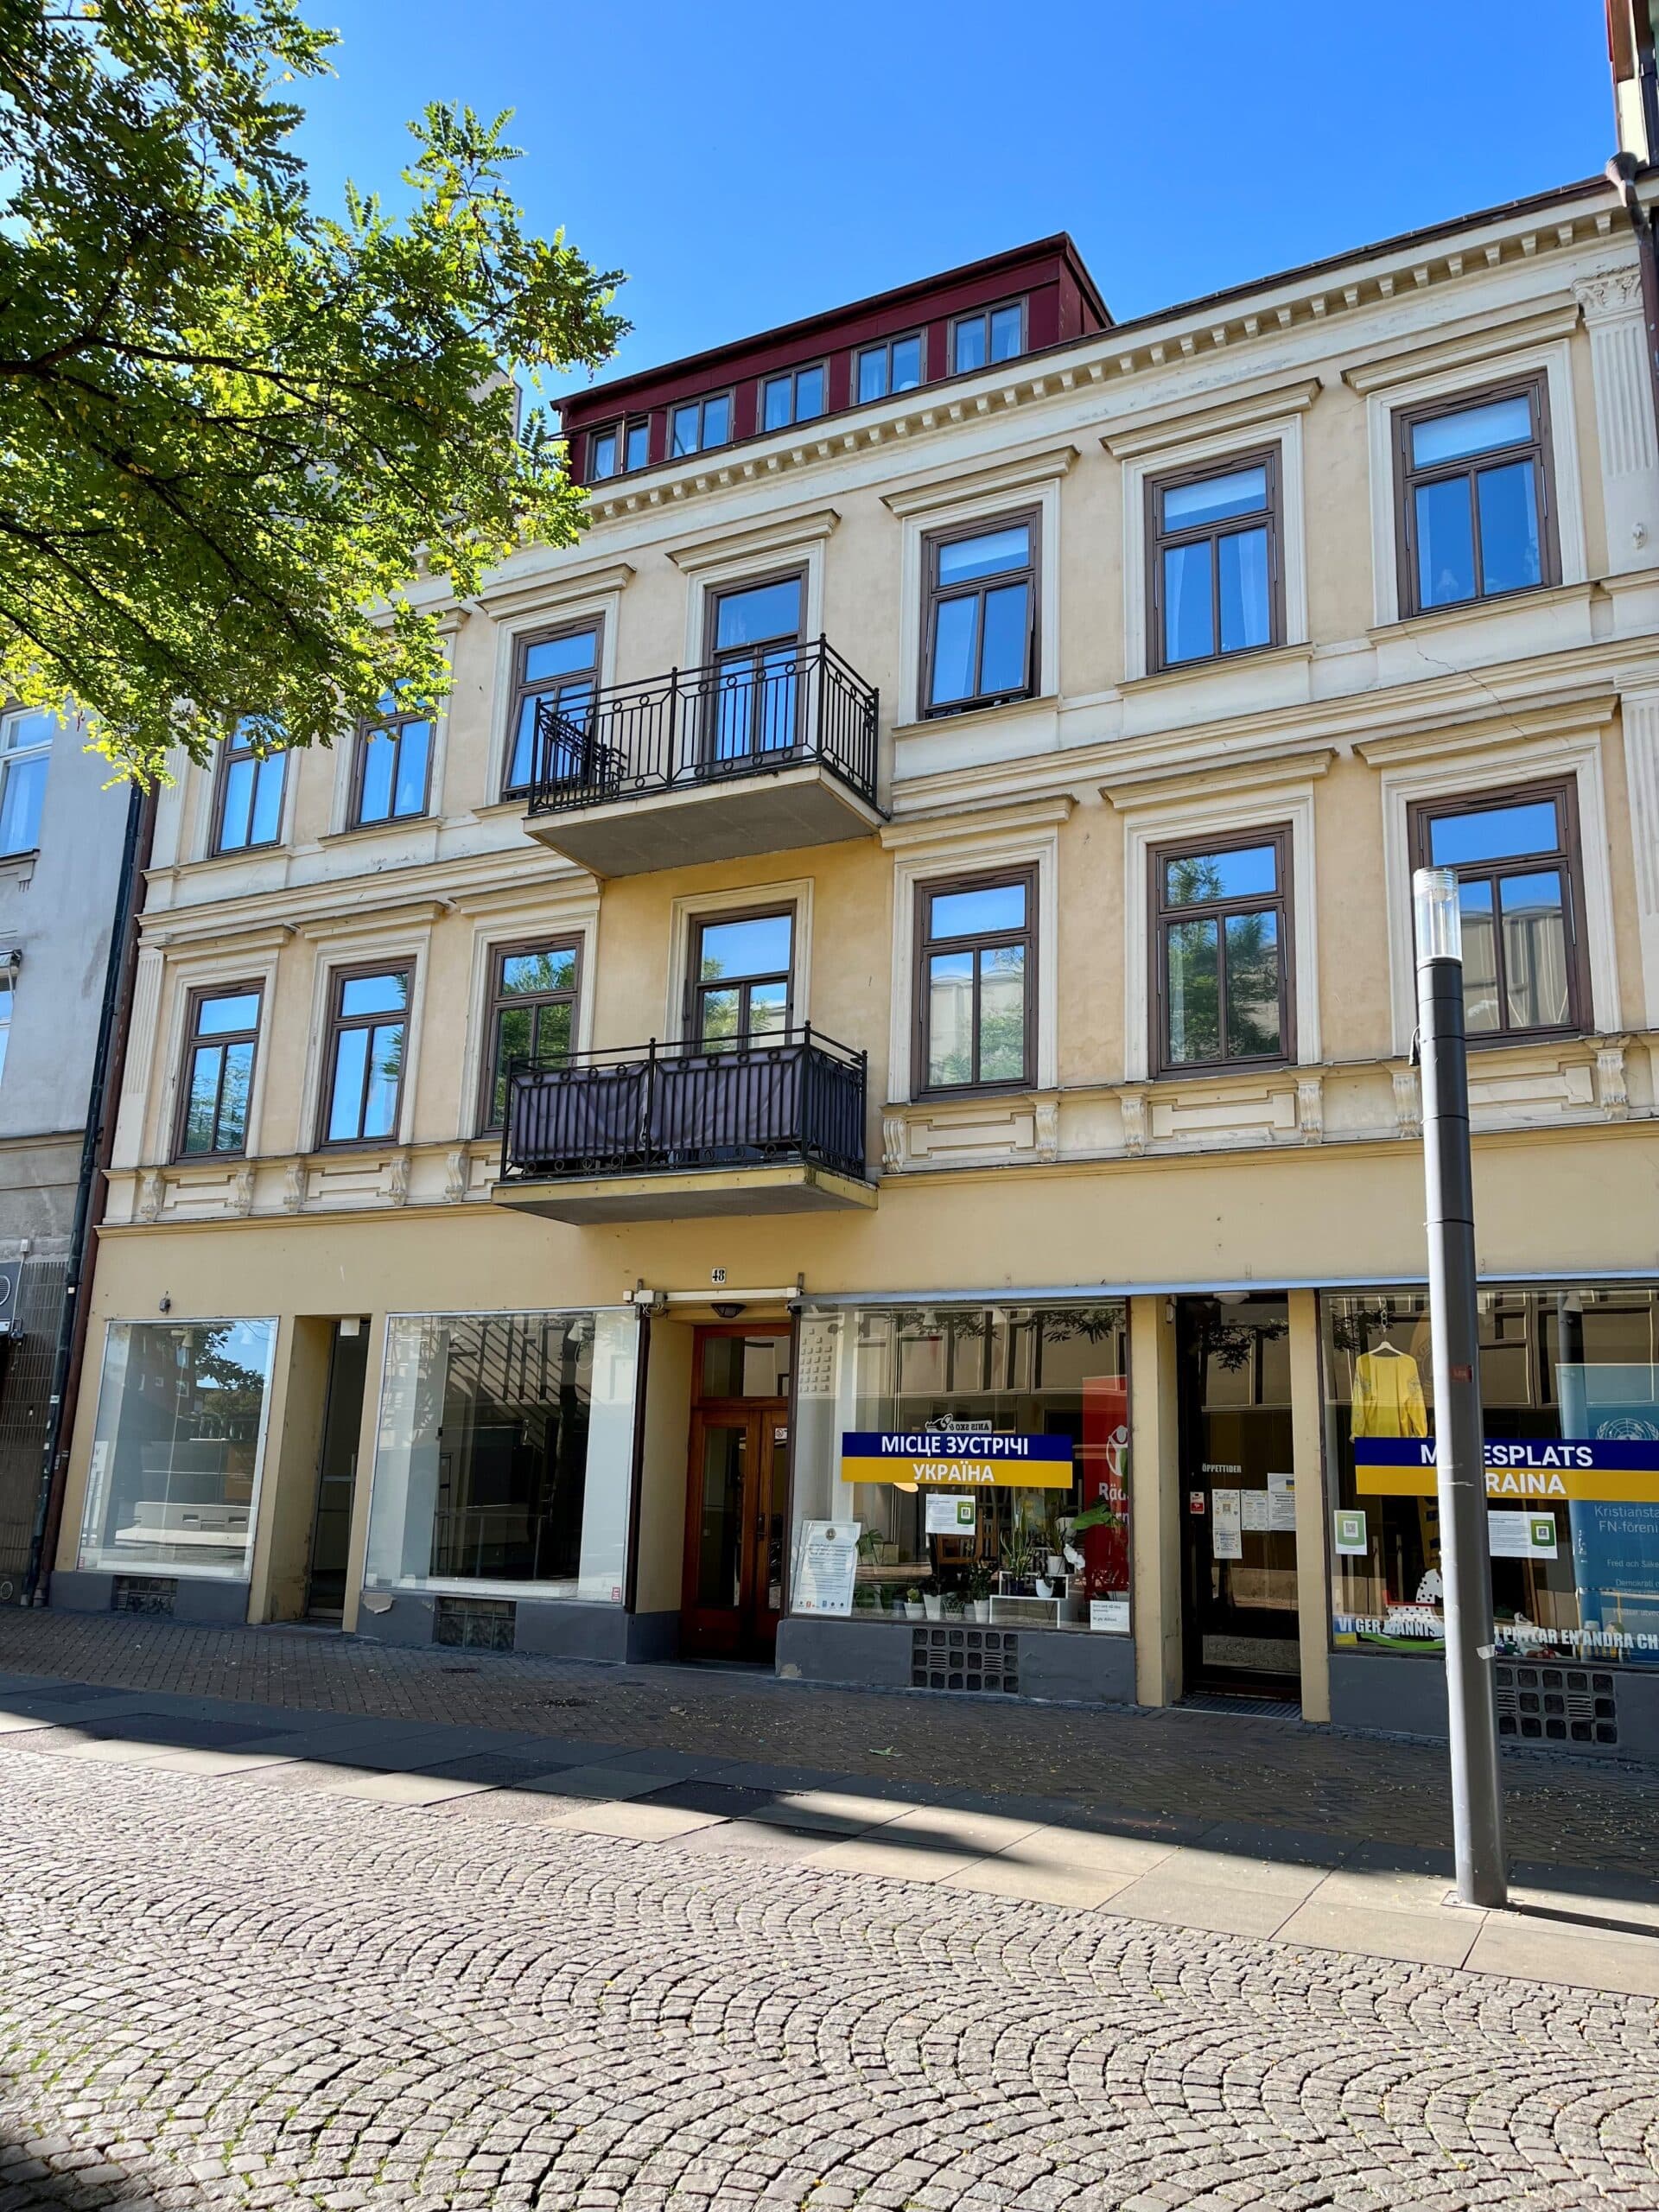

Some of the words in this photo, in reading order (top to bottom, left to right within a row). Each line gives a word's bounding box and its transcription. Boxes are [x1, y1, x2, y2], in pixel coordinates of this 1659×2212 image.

[712, 1269, 725, 1281] 48
[881, 1436, 941, 1457] МІСЦЕ
[946, 1436, 1028, 1455] ЗУСТРІЧІ
[1421, 1444, 1593, 1467] MESPLATS
[912, 1460, 995, 1482] УКРАЇНА
[1485, 1472, 1567, 1495] RAINA
[1338, 1617, 1353, 1632] VI
[1355, 1618, 1381, 1634] GER
[1560, 1629, 1580, 1645] EN
[1582, 1630, 1634, 1649] ANDRA
